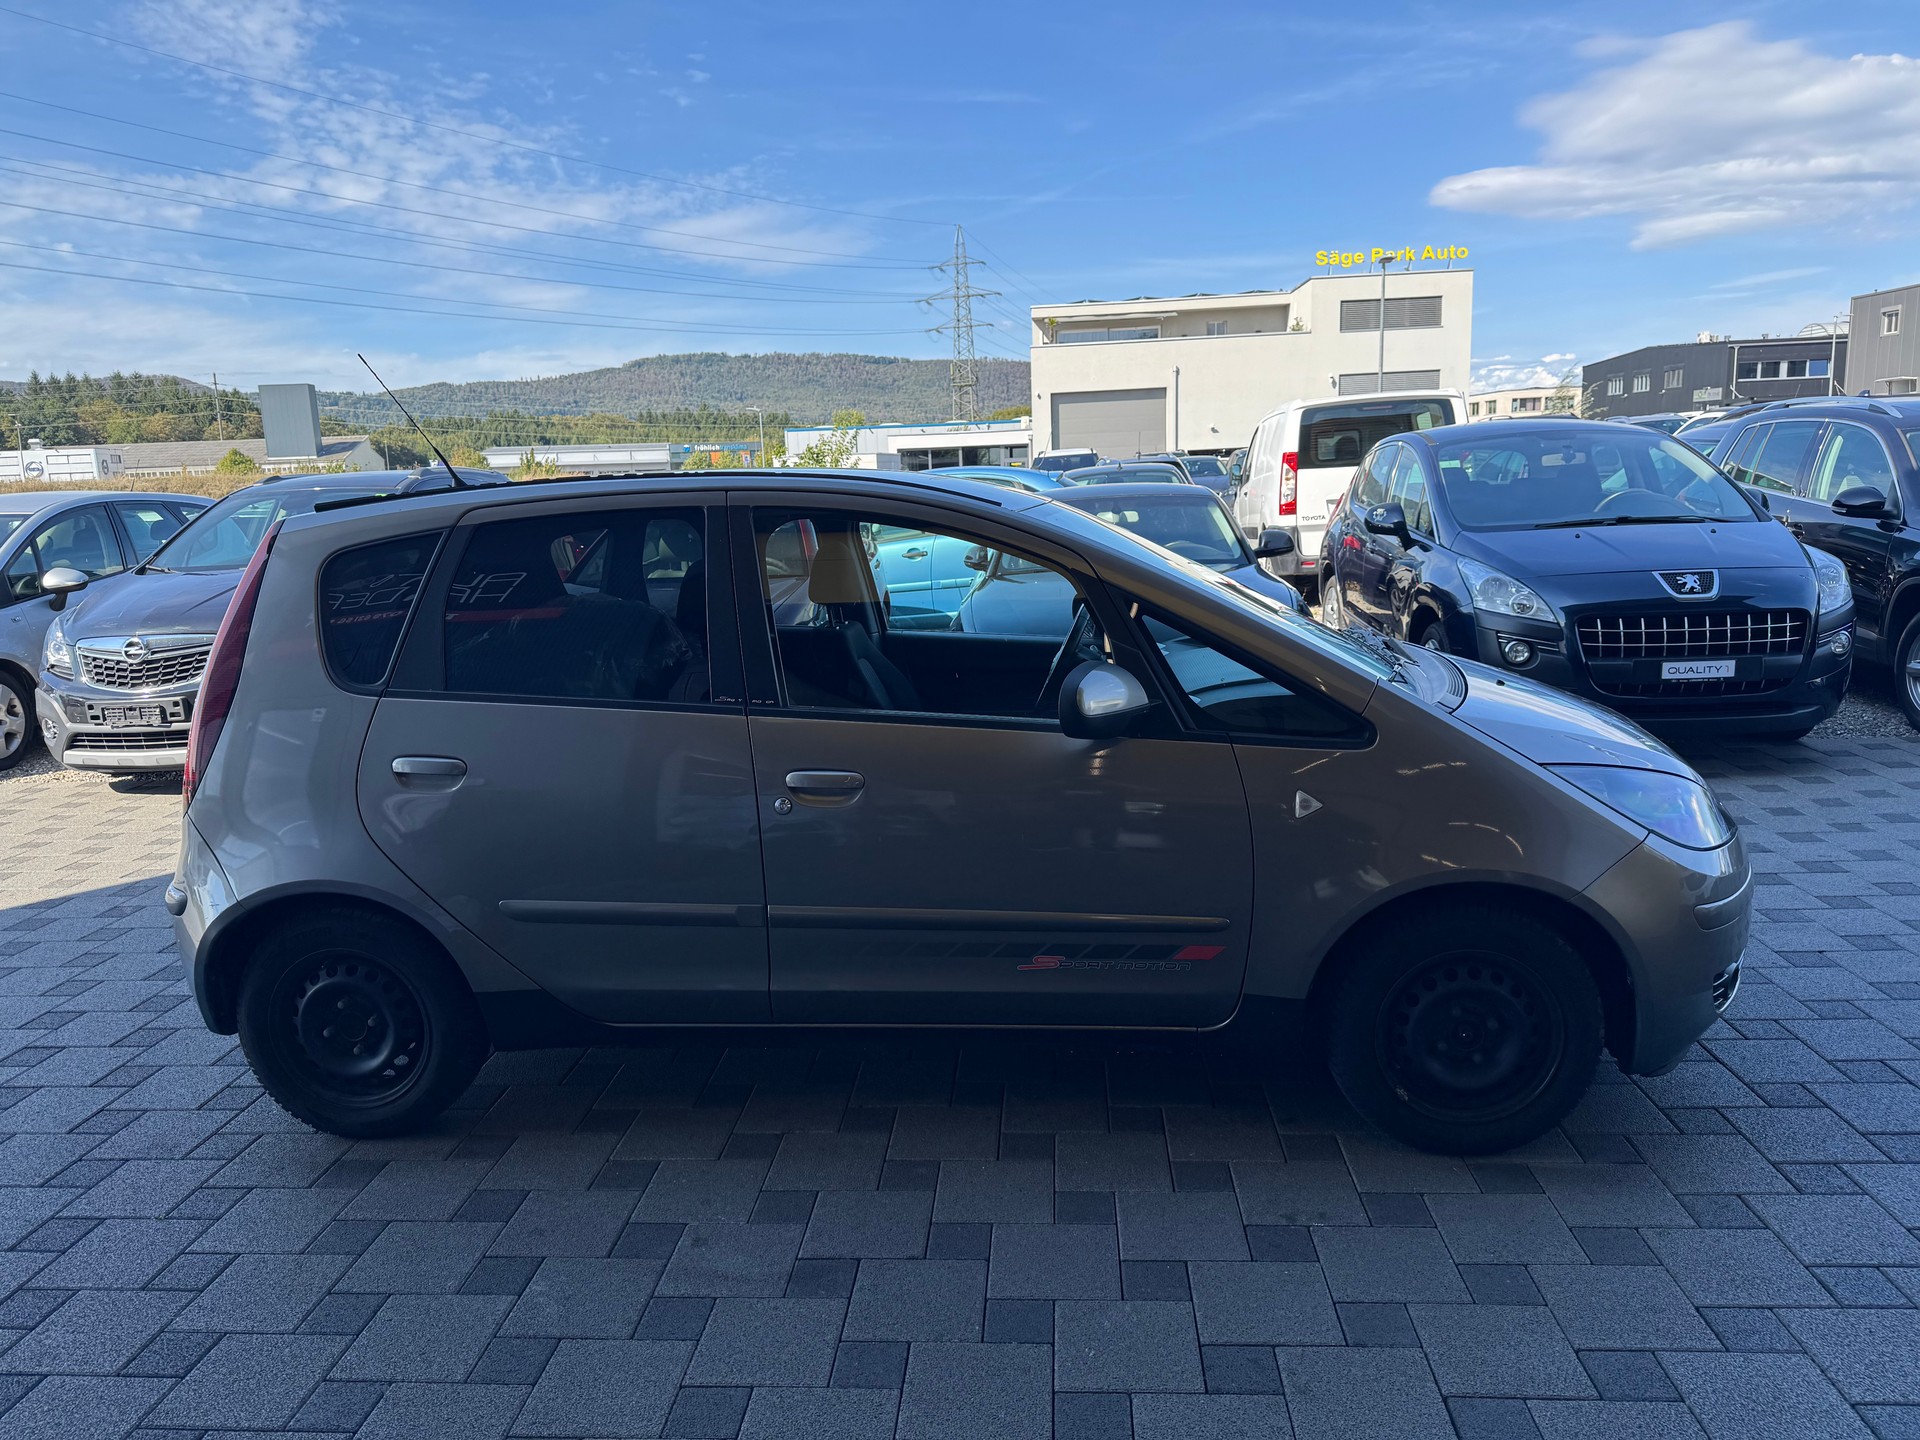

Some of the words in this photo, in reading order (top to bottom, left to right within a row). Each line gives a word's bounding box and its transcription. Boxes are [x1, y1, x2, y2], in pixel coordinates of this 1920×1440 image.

[1315, 250, 1365, 268] Säge
[1421, 245, 1469, 260] Auto
[1667, 665, 1722, 675] QUALITY
